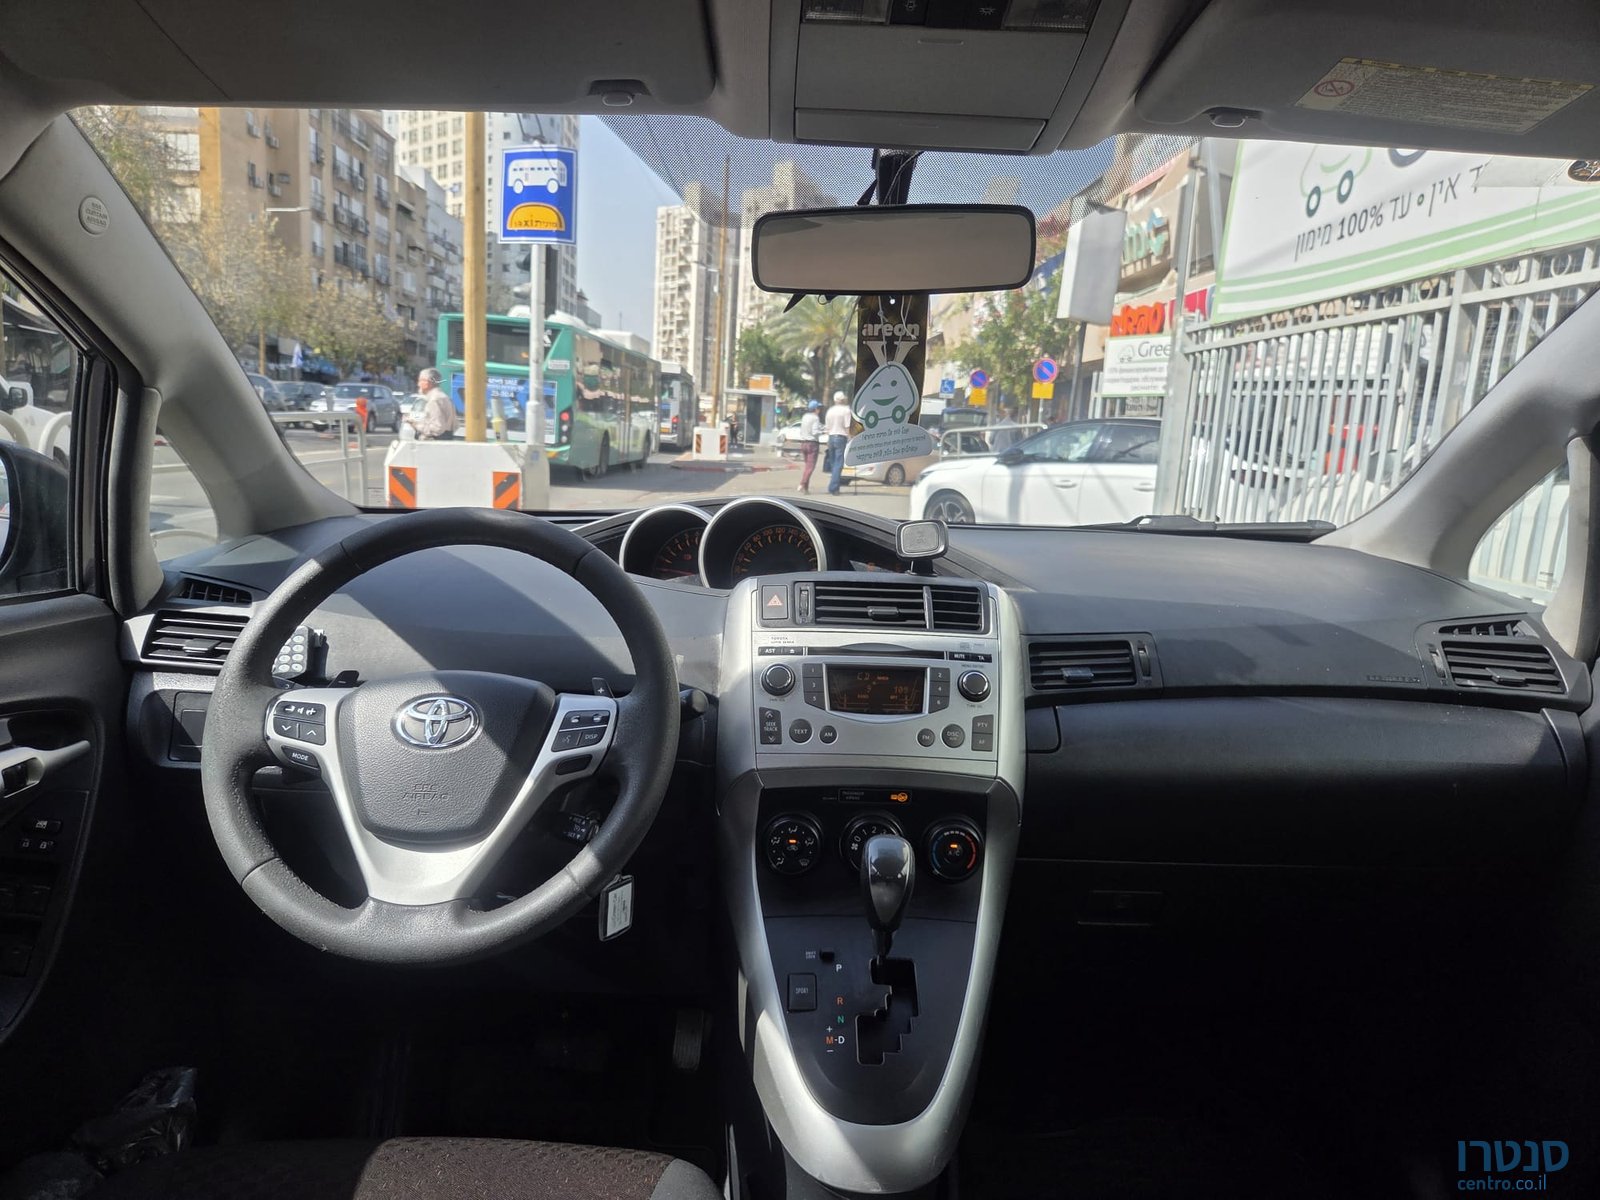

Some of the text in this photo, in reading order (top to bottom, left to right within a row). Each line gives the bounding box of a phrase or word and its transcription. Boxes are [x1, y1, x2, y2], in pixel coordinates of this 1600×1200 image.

[1294, 192, 1411, 262] עד 100% מימון
[861, 323, 920, 337] areon
[291, 752, 309, 761] MODE
[871, 826, 877, 834] 2
[835, 964, 843, 973] P
[795, 987, 809, 995] SPORT
[836, 996, 844, 1005] R
[837, 1015, 845, 1024] N
